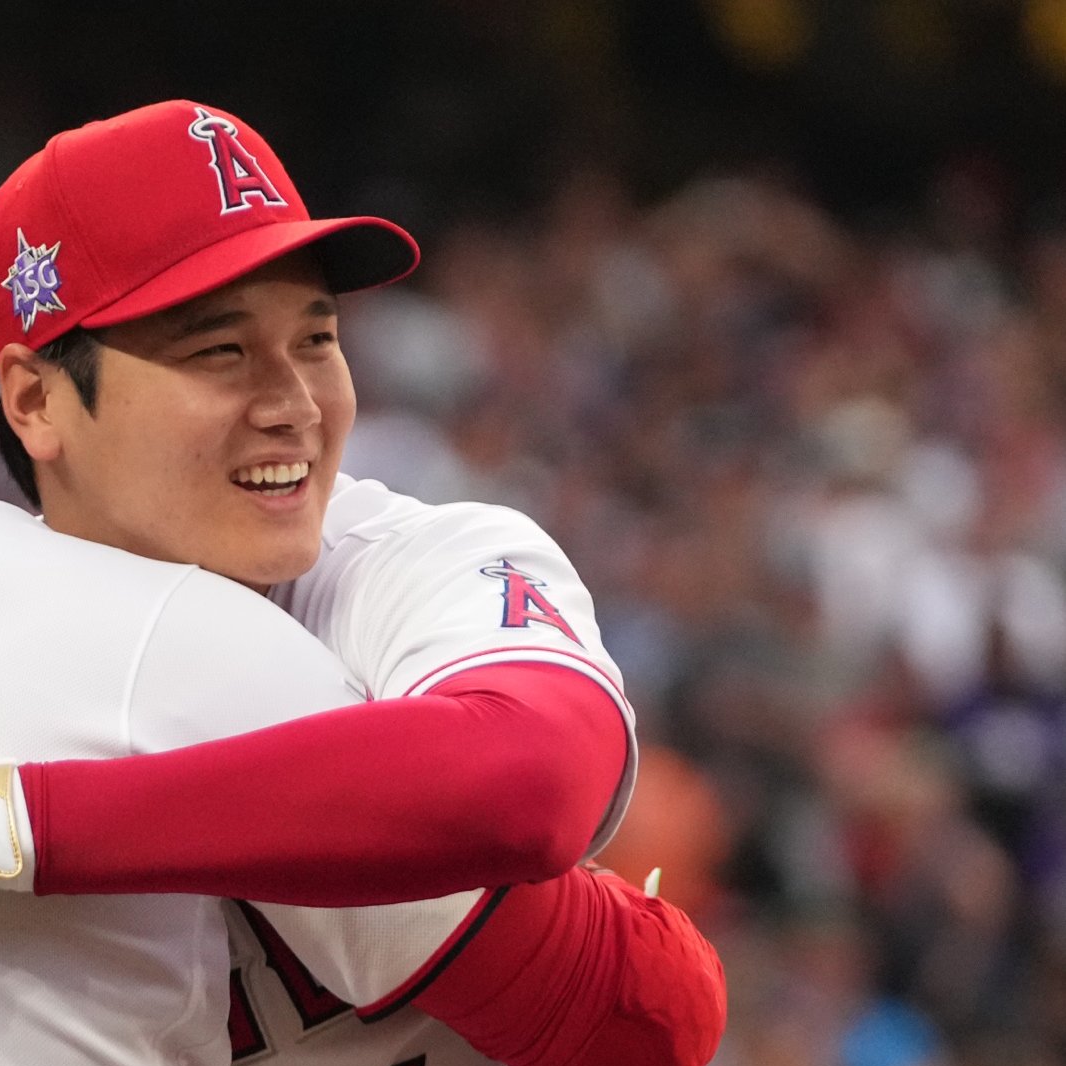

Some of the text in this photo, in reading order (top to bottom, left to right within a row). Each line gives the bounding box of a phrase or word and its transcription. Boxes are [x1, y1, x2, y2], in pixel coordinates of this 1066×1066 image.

[188, 106, 289, 216] A
[14, 259, 58, 311] ASG
[479, 557, 589, 653] A
